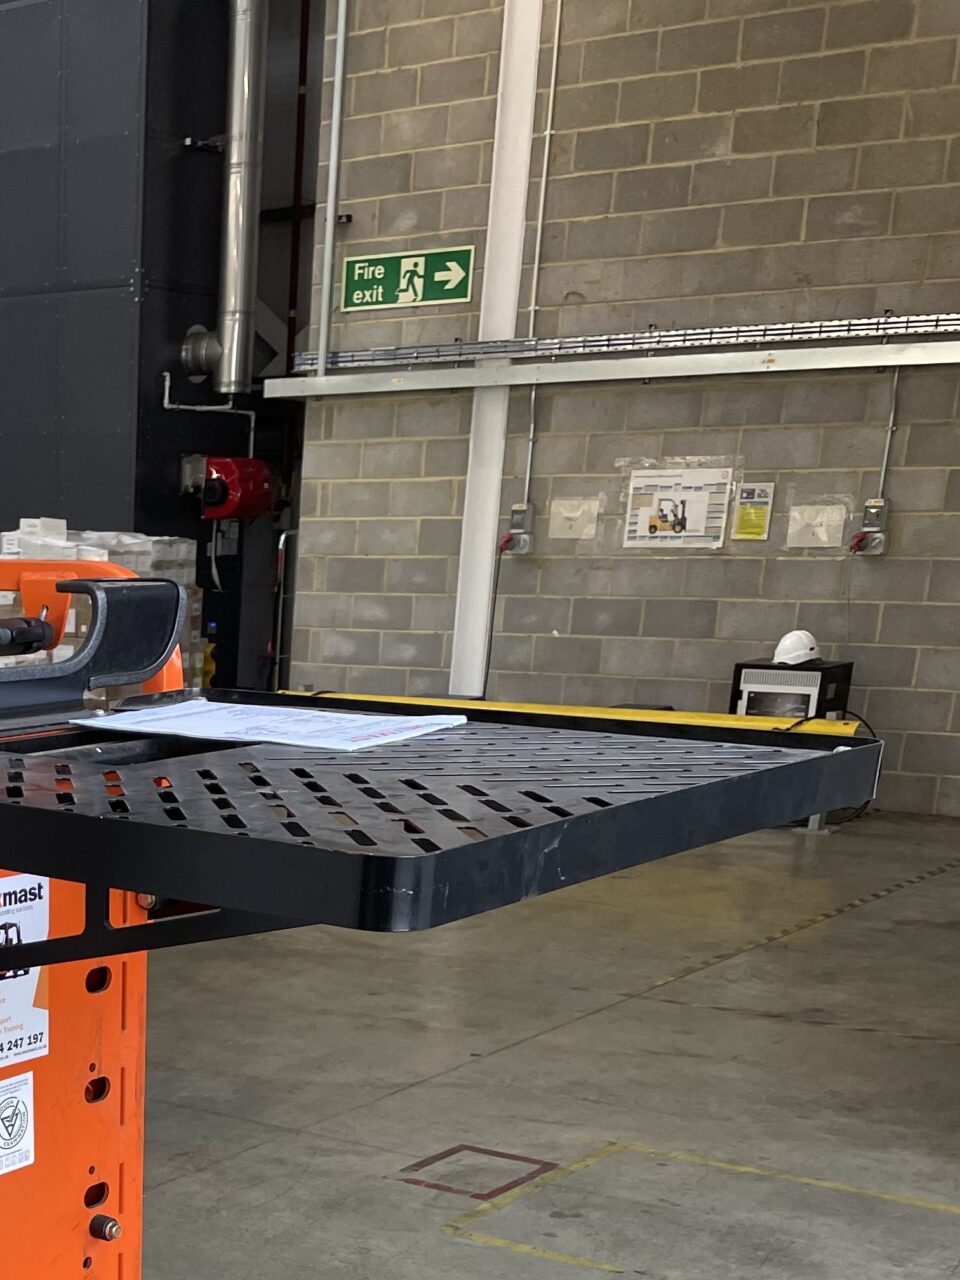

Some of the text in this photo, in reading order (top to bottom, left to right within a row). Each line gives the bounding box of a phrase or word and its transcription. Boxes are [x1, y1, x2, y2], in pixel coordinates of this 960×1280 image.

[354, 262, 385, 281] Fire
[353, 285, 384, 304] exit
[7, 1037, 24, 1052] 247
[27, 1032, 44, 1046] 197
